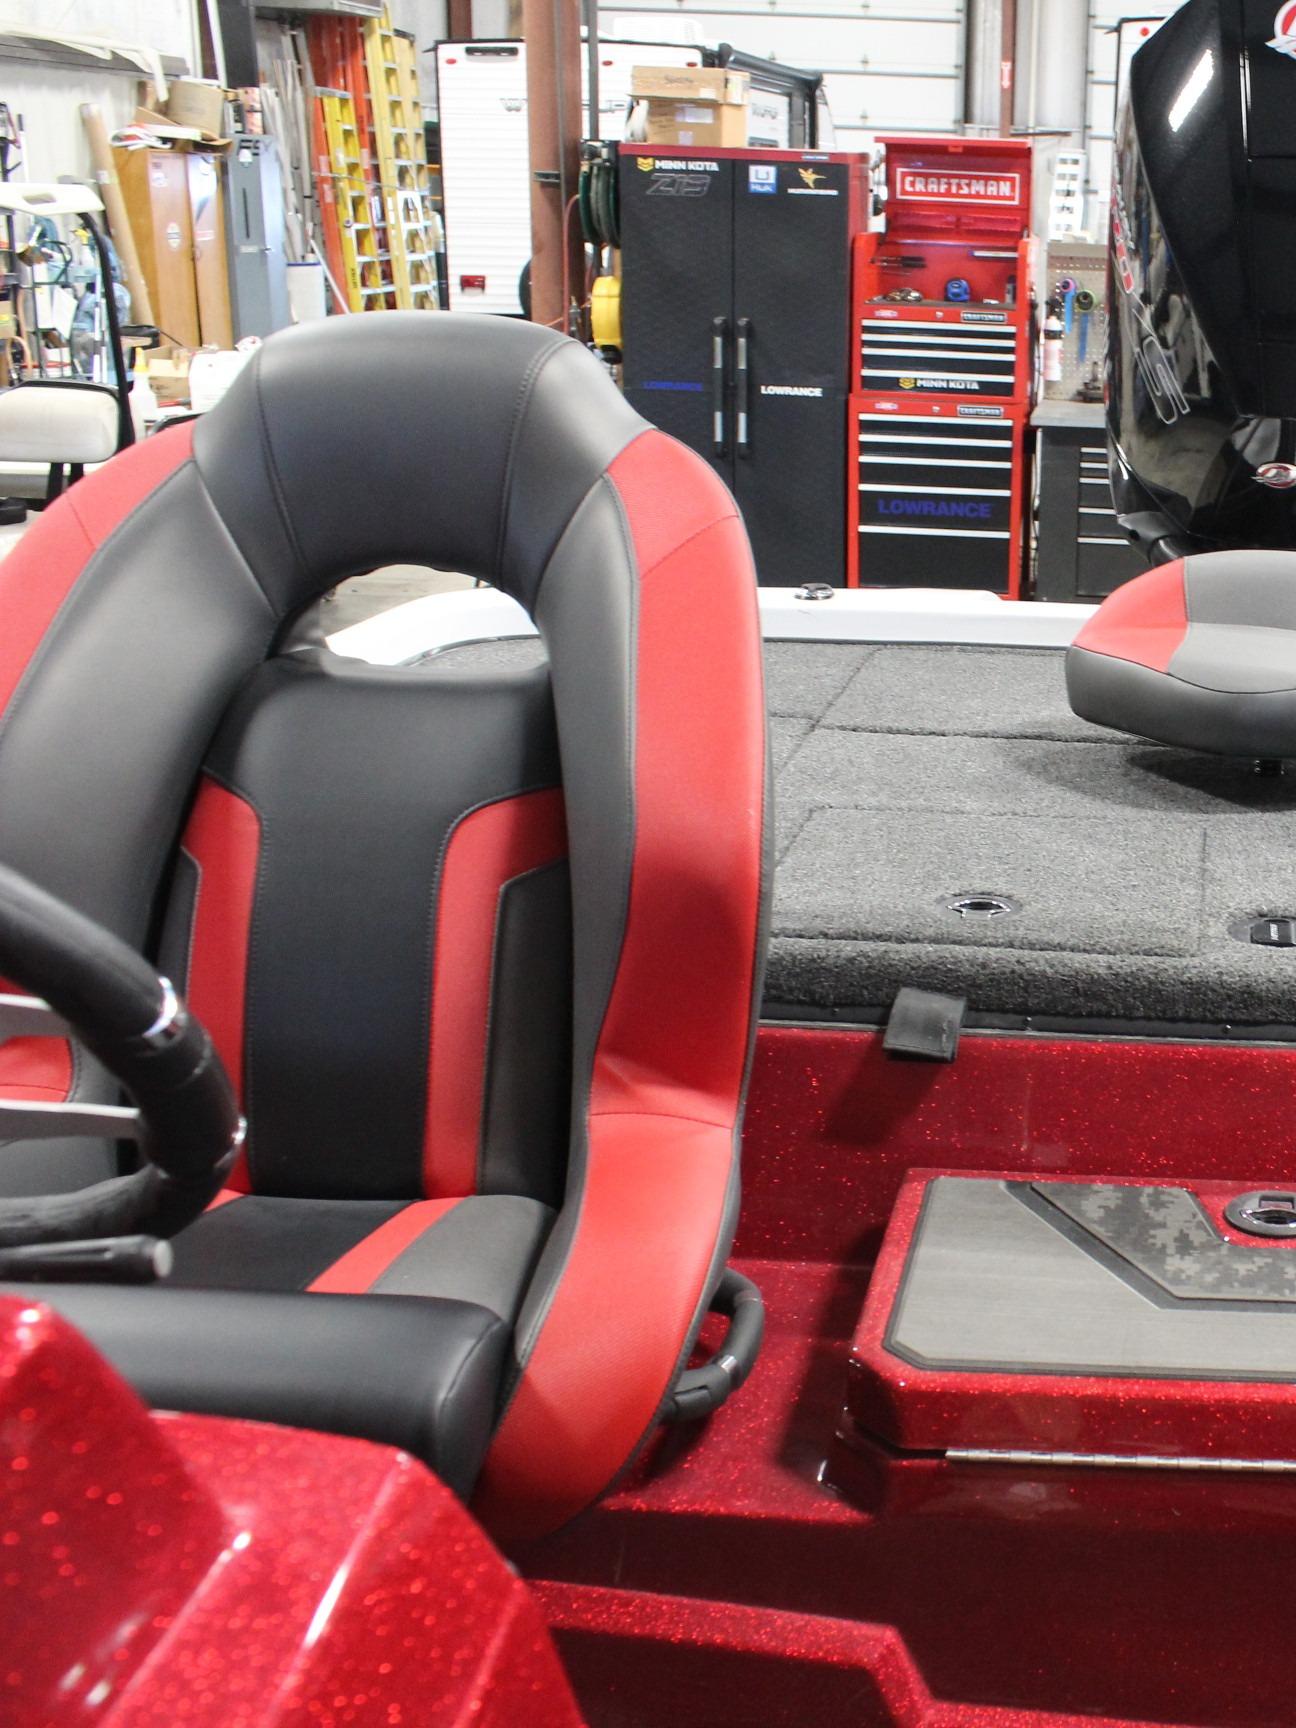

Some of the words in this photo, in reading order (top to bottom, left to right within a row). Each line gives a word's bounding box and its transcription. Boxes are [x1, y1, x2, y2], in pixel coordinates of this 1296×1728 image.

[655, 160, 686, 170] MINN
[688, 162, 720, 172] KOTA
[904, 176, 1012, 197] CRAFTSMAN
[916, 379, 948, 388] MINN
[949, 380, 980, 390] KOTA
[760, 385, 823, 397] LOWRANCE
[878, 498, 992, 518] LOWRANCE
